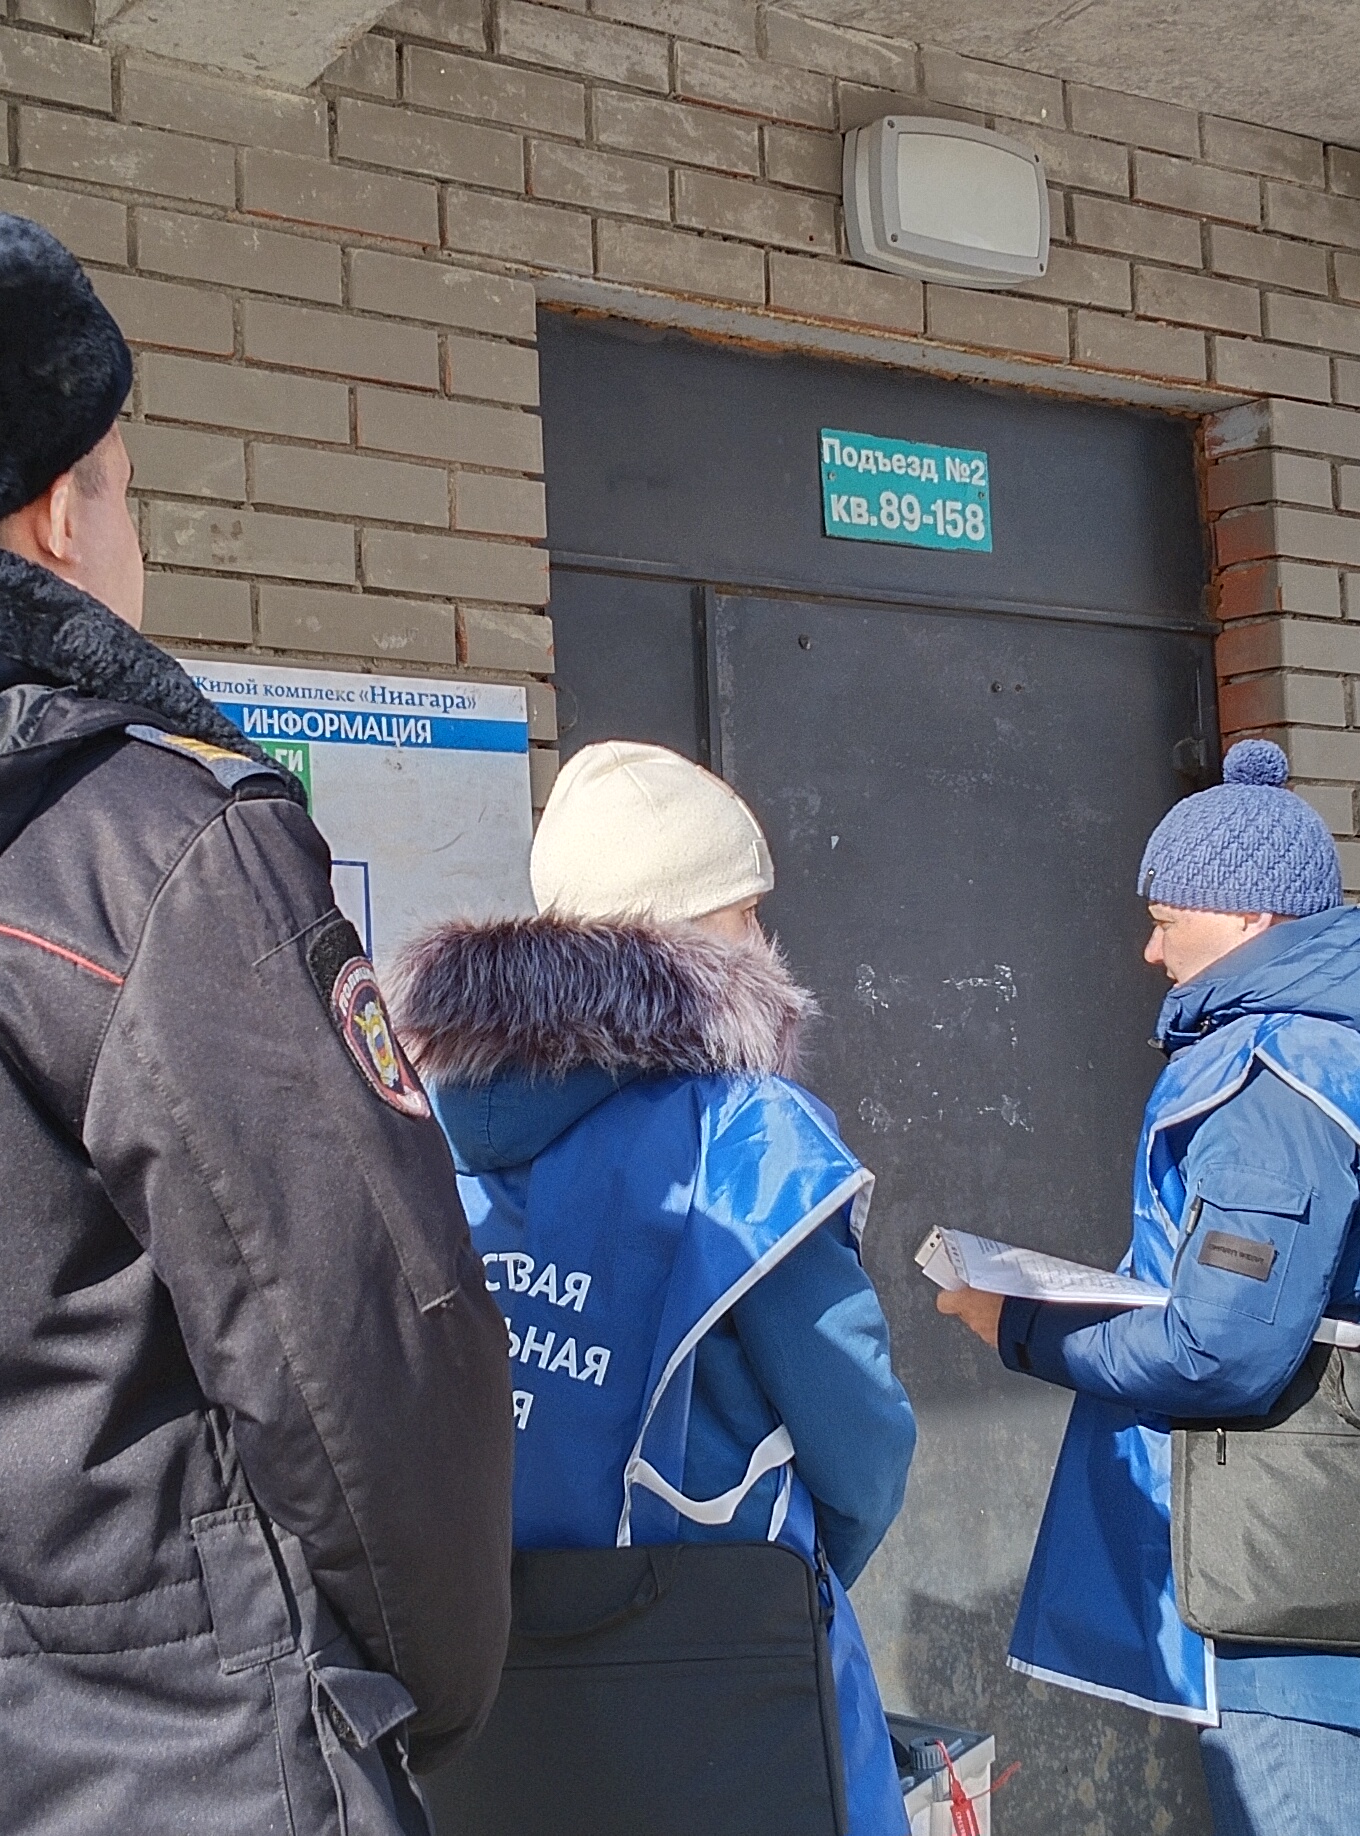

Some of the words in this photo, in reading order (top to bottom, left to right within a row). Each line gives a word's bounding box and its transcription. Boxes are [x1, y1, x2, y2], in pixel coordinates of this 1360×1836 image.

[821, 436, 939, 484] Подъезд
[945, 456, 986, 487] №2
[829, 490, 986, 541] кв.89-158
[263, 683, 356, 703] комплекс
[359, 685, 478, 711] «Ниагара»
[242, 706, 432, 746] ИНФОРМАЦИЯ
